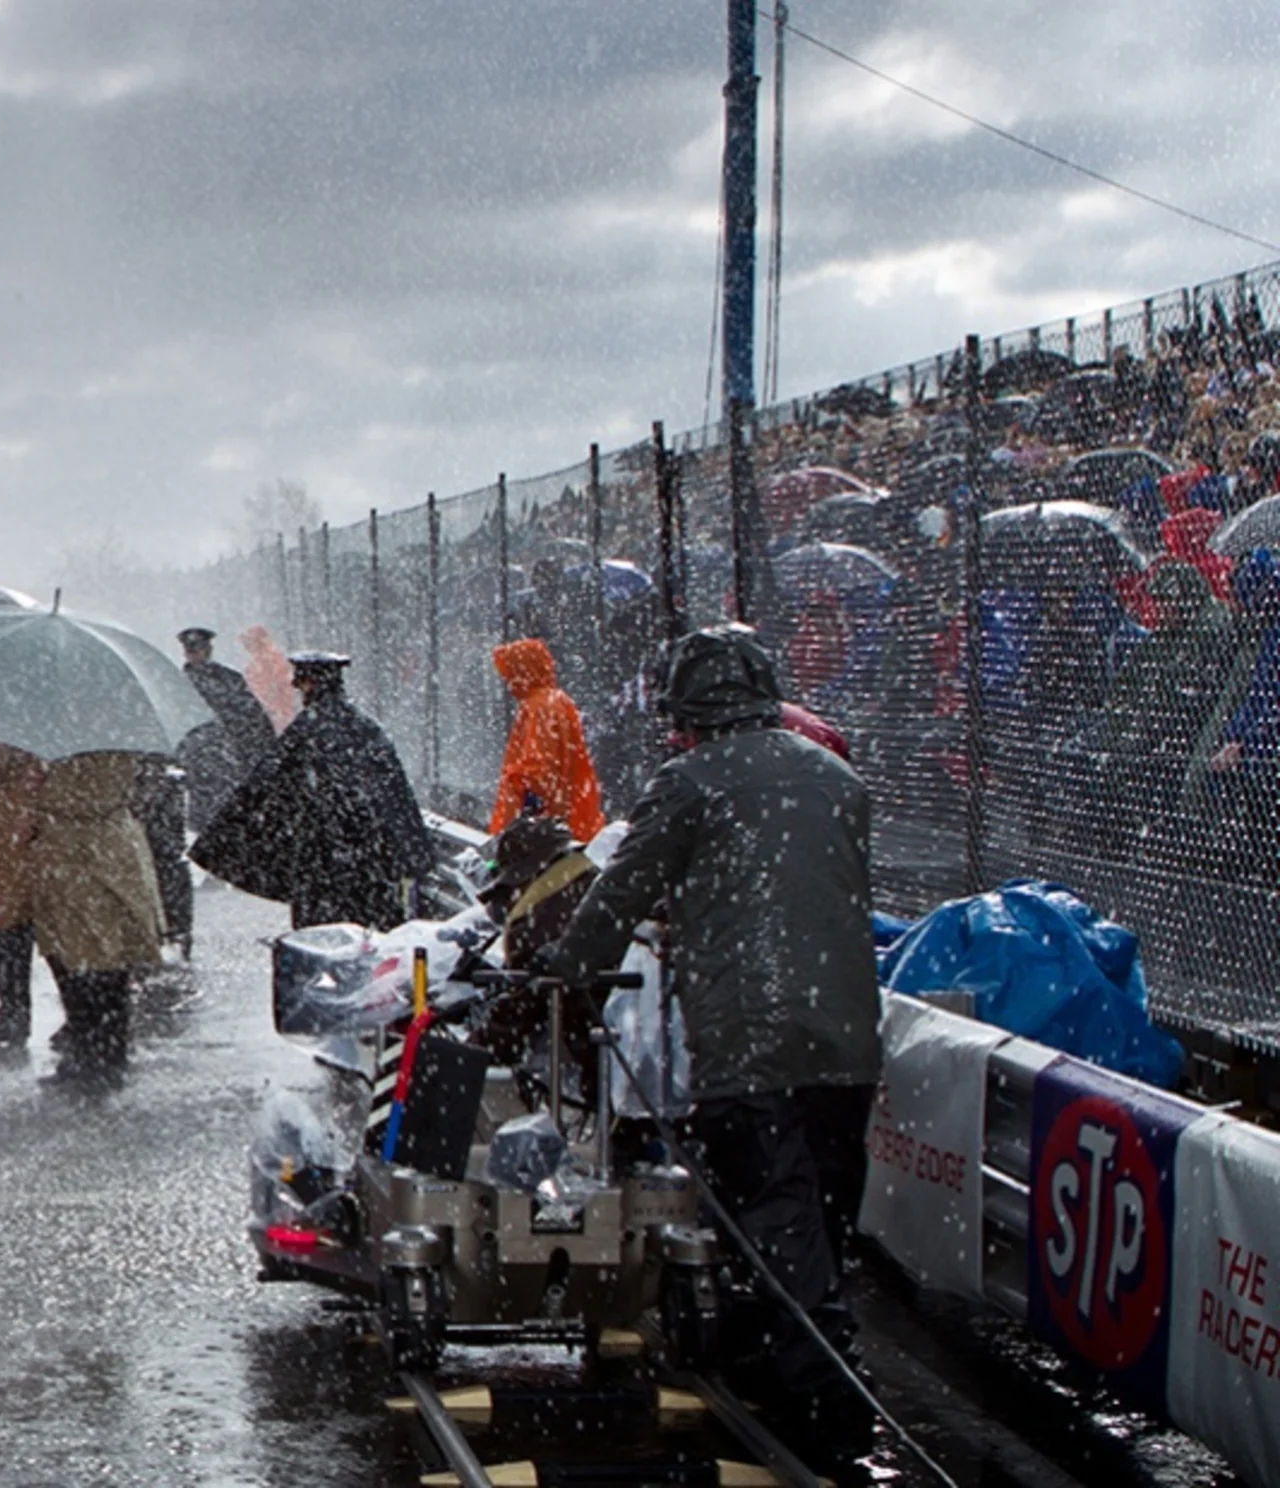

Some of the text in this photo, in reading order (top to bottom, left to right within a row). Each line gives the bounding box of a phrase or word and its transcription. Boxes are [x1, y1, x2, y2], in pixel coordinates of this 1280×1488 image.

[915, 1142, 967, 1194] EDGE
[1046, 1124, 1145, 1318] STP
[1217, 1237, 1268, 1306] THE
[1198, 1288, 1280, 1380] RACER
